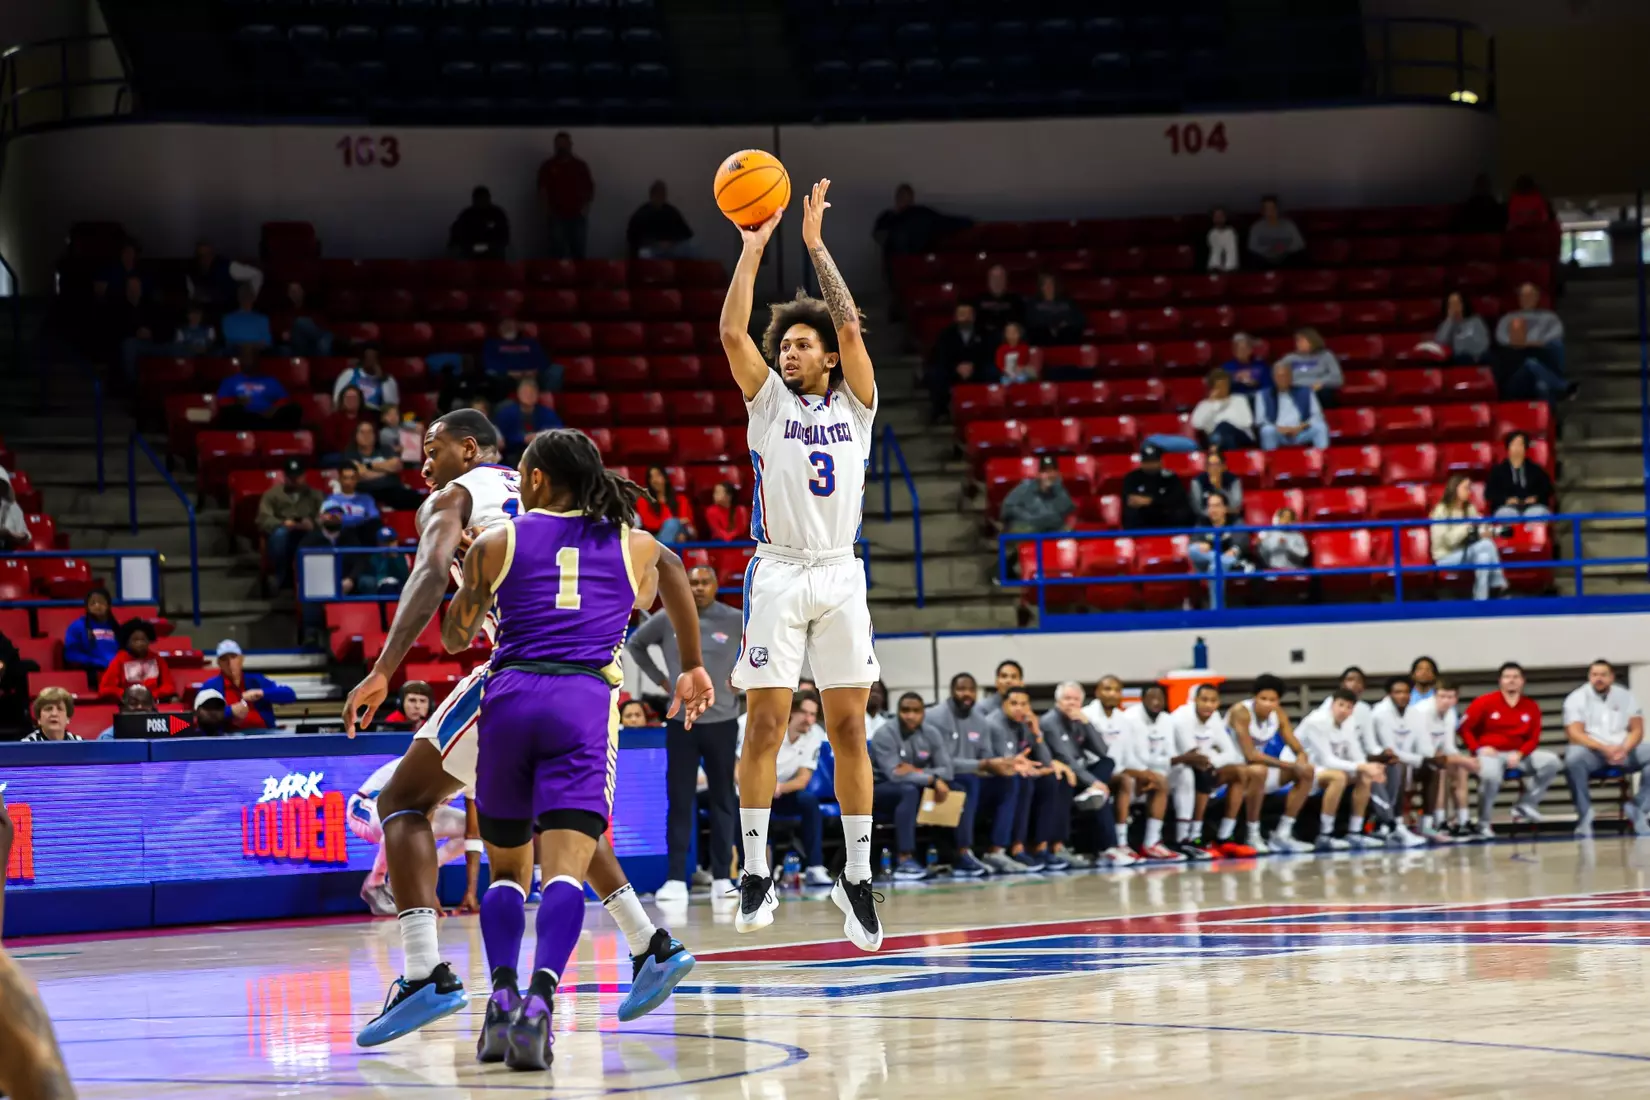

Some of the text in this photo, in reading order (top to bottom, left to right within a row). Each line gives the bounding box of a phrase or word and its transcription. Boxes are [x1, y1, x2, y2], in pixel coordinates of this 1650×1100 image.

[336, 135, 400, 168] 103
[1164, 122, 1229, 155] 104
[808, 450, 836, 497] 3
[555, 546, 581, 610] 1
[146, 717, 169, 733] POSS.
[257, 770, 325, 803] BARK
[241, 790, 348, 863] LOUDER
